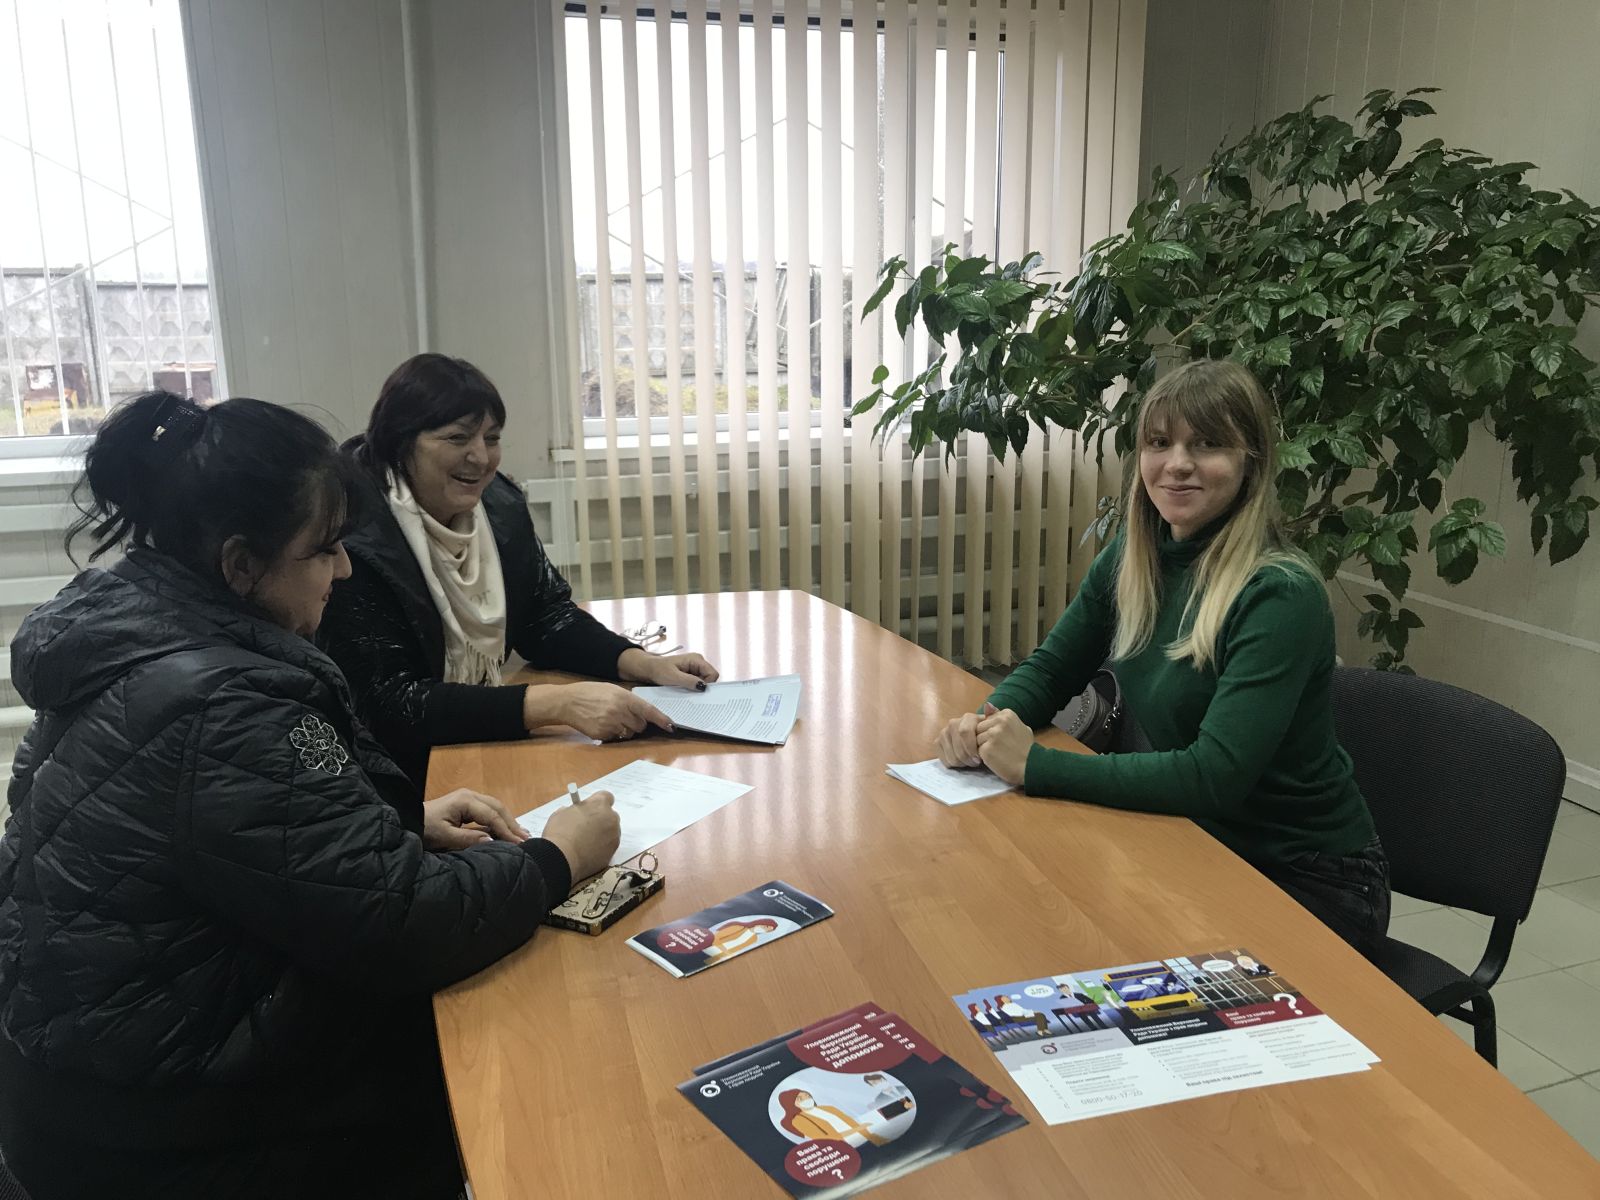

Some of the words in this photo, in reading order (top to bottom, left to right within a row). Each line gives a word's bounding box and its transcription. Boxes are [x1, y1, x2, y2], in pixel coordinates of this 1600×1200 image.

[1273, 992, 1303, 1015] ?
[803, 1022, 862, 1050] Уповноважений
[820, 1030, 858, 1050] Верховної
[820, 1046, 840, 1057] Ради
[840, 1033, 869, 1049] України
[829, 1049, 849, 1060] прав
[848, 1036, 877, 1052] людини
[832, 1042, 884, 1069] допоможе
[796, 1143, 819, 1157] Ваші
[796, 1151, 822, 1166] права
[821, 1145, 833, 1153] та
[803, 1150, 841, 1170] свободи
[806, 1154, 850, 1178] порушено
[831, 1168, 844, 1180] ?
